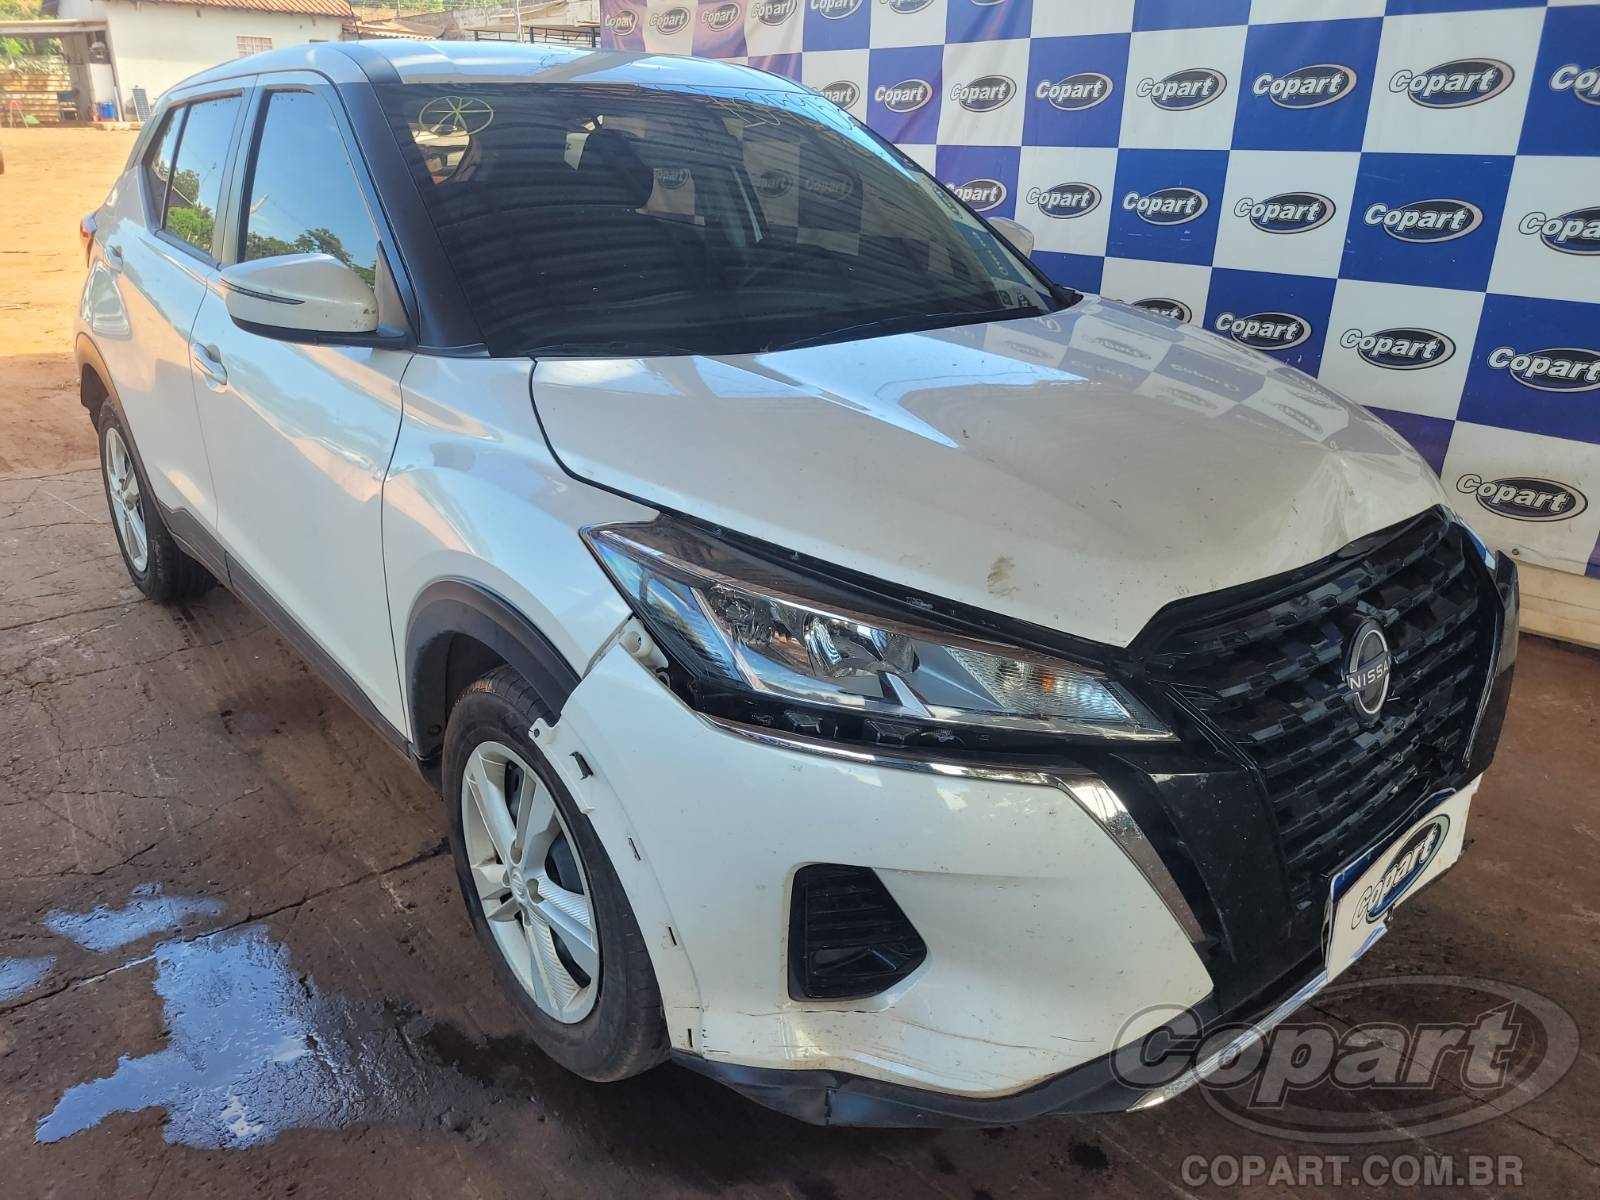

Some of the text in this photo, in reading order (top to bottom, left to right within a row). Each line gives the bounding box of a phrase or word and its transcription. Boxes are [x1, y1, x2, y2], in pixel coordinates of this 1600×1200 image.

[650, 13, 686, 28] Copart
[701, 7, 737, 25] Copart
[874, 84, 924, 104] Copart
[950, 82, 1007, 103] Copart
[1035, 79, 1103, 101] Copart
[1136, 75, 1216, 101] Copart
[1252, 69, 1345, 100] Copart
[1389, 66, 1498, 99] Copart
[1026, 186, 1091, 210] Copart
[1123, 191, 1199, 215] Copart
[1234, 198, 1320, 224] Copart
[1365, 202, 1468, 233] Copart
[1215, 312, 1299, 340] Copart
[1340, 328, 1441, 360] Copart
[1488, 347, 1600, 383] Copart
[1456, 473, 1571, 513] Copart
[1347, 655, 1391, 690] NISSA
[1352, 822, 1439, 930] Copart
